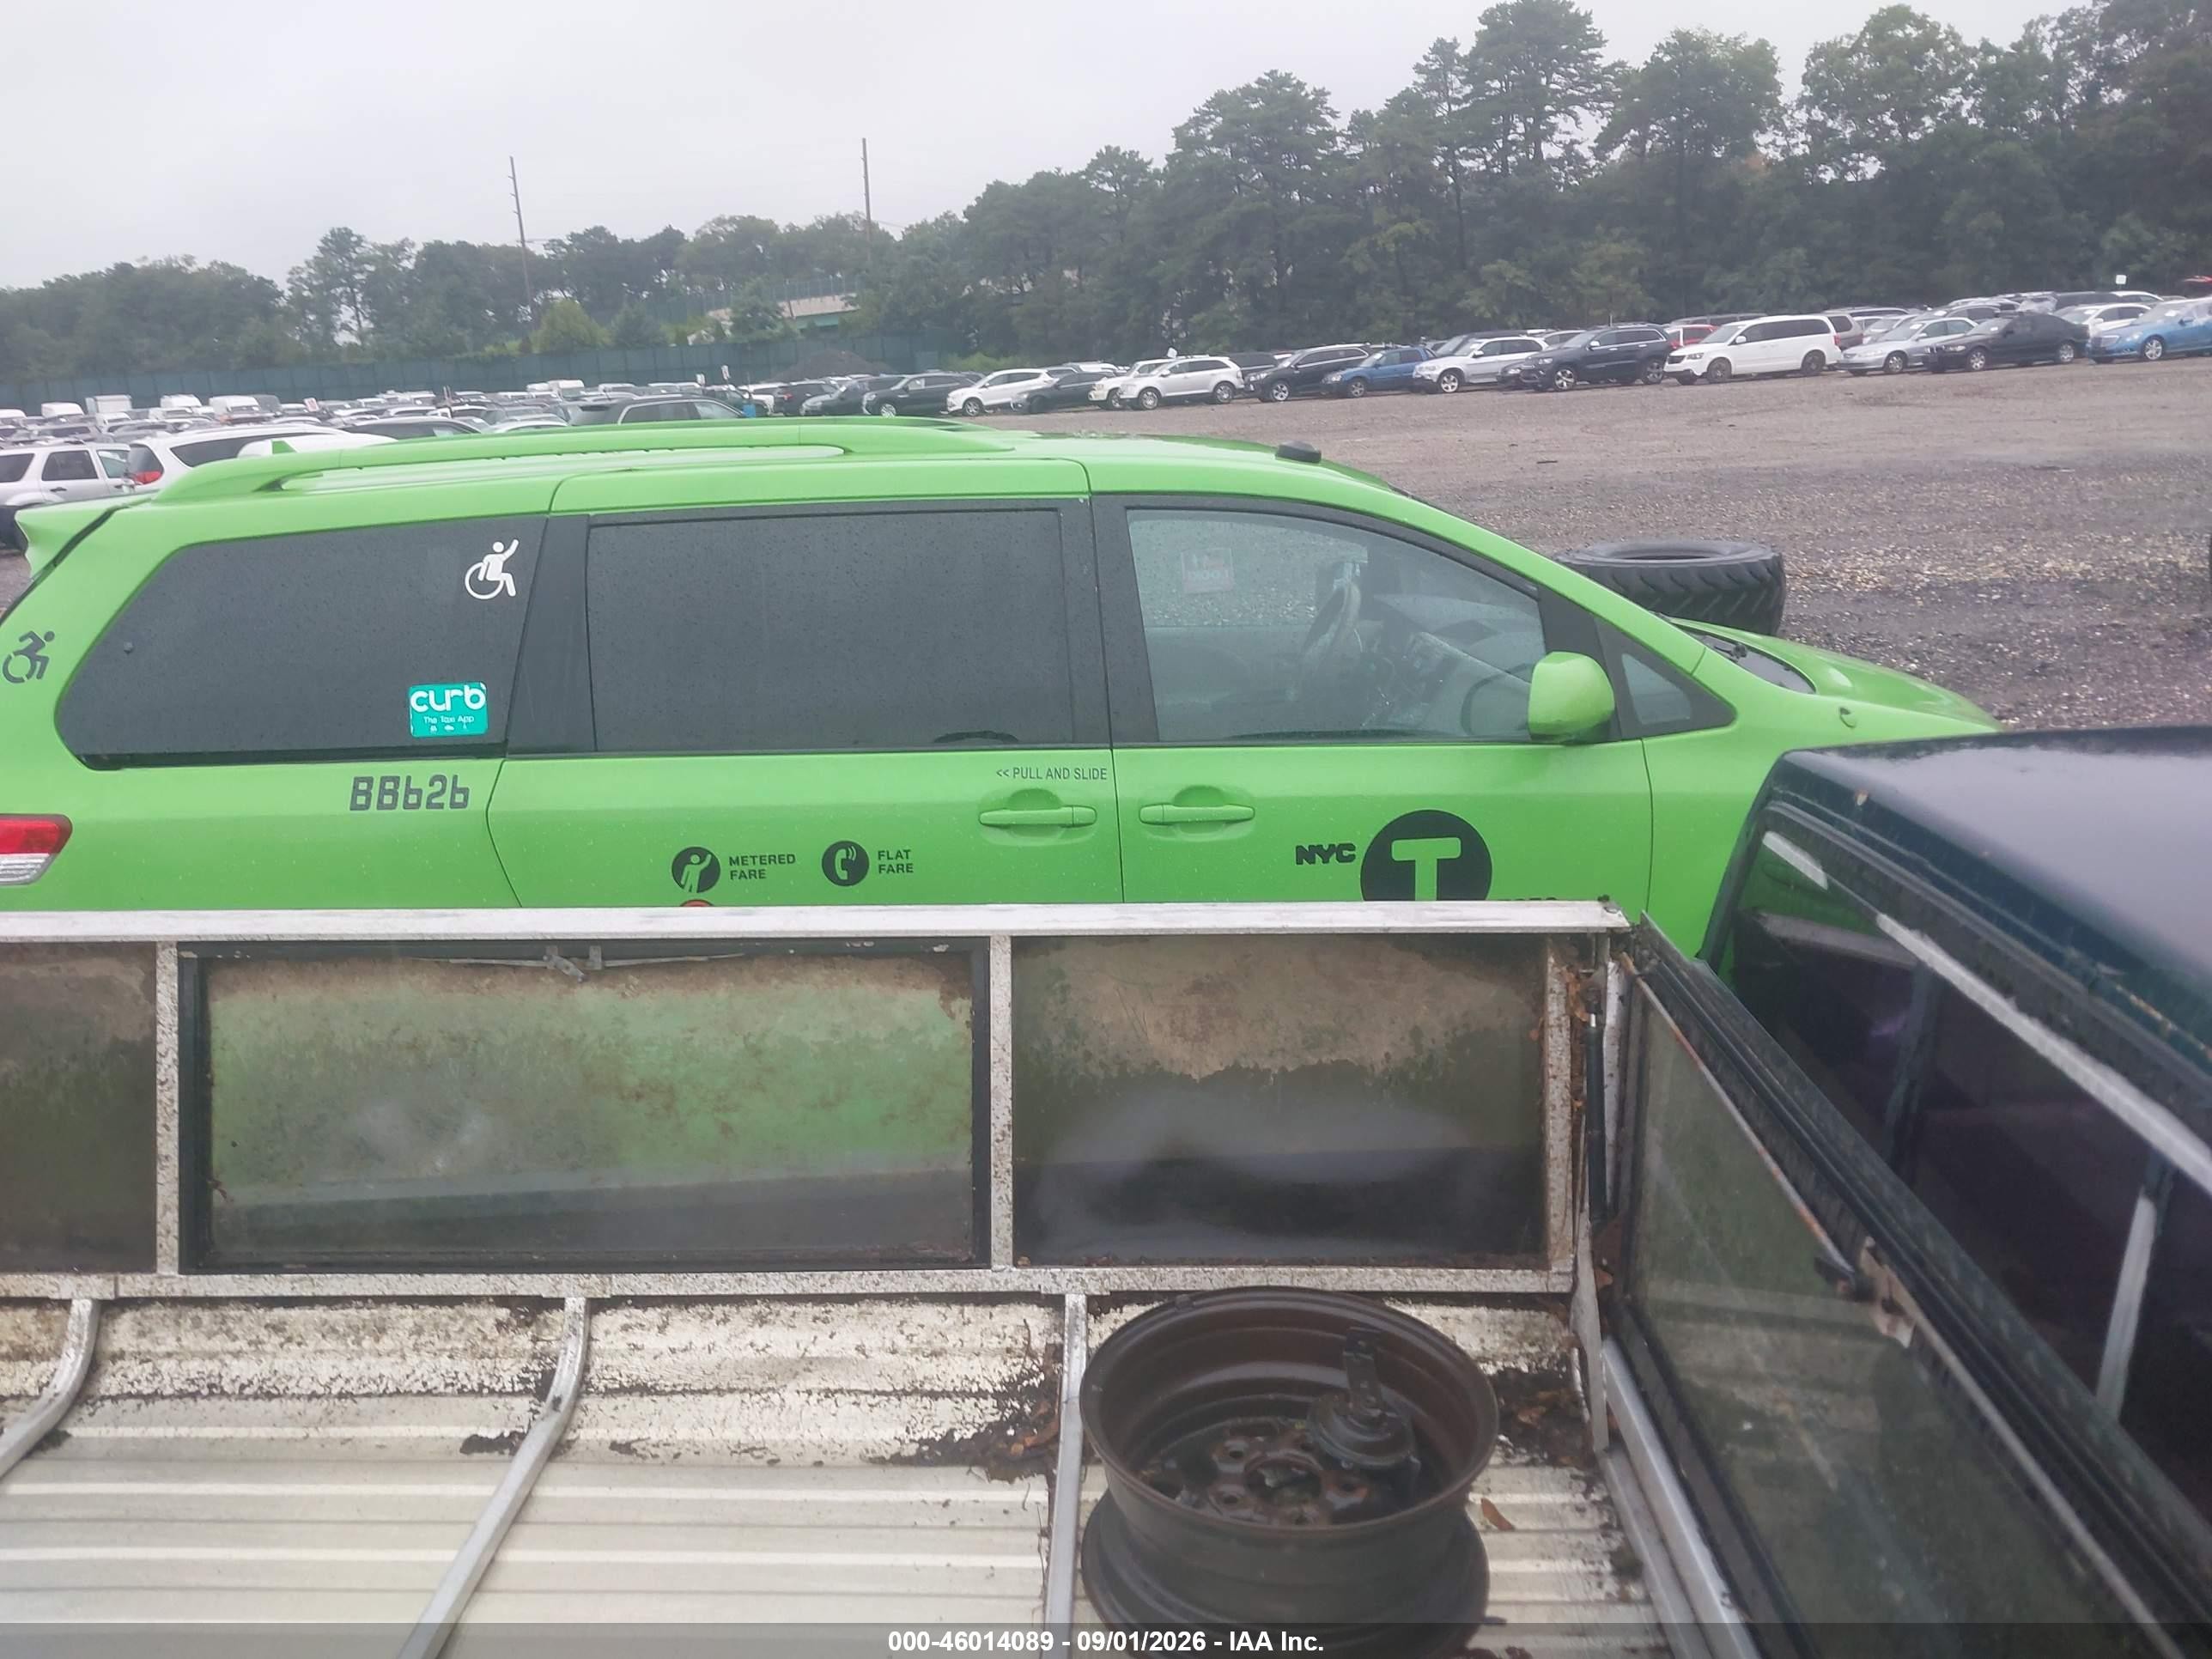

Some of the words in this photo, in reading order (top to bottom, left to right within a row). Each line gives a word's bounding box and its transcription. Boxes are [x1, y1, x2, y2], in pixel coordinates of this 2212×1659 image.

[410, 684, 486, 713] curb
[423, 715, 438, 725] The
[457, 714, 475, 725] App
[1012, 767, 1043, 780] PULL
[1045, 767, 1071, 780] AND
[1073, 767, 1108, 781] SLIDE
[729, 853, 796, 867] METERED
[877, 849, 911, 861] FLAT
[1295, 842, 1357, 866] NYC
[730, 868, 767, 881] FARE
[878, 862, 915, 875] FARE
